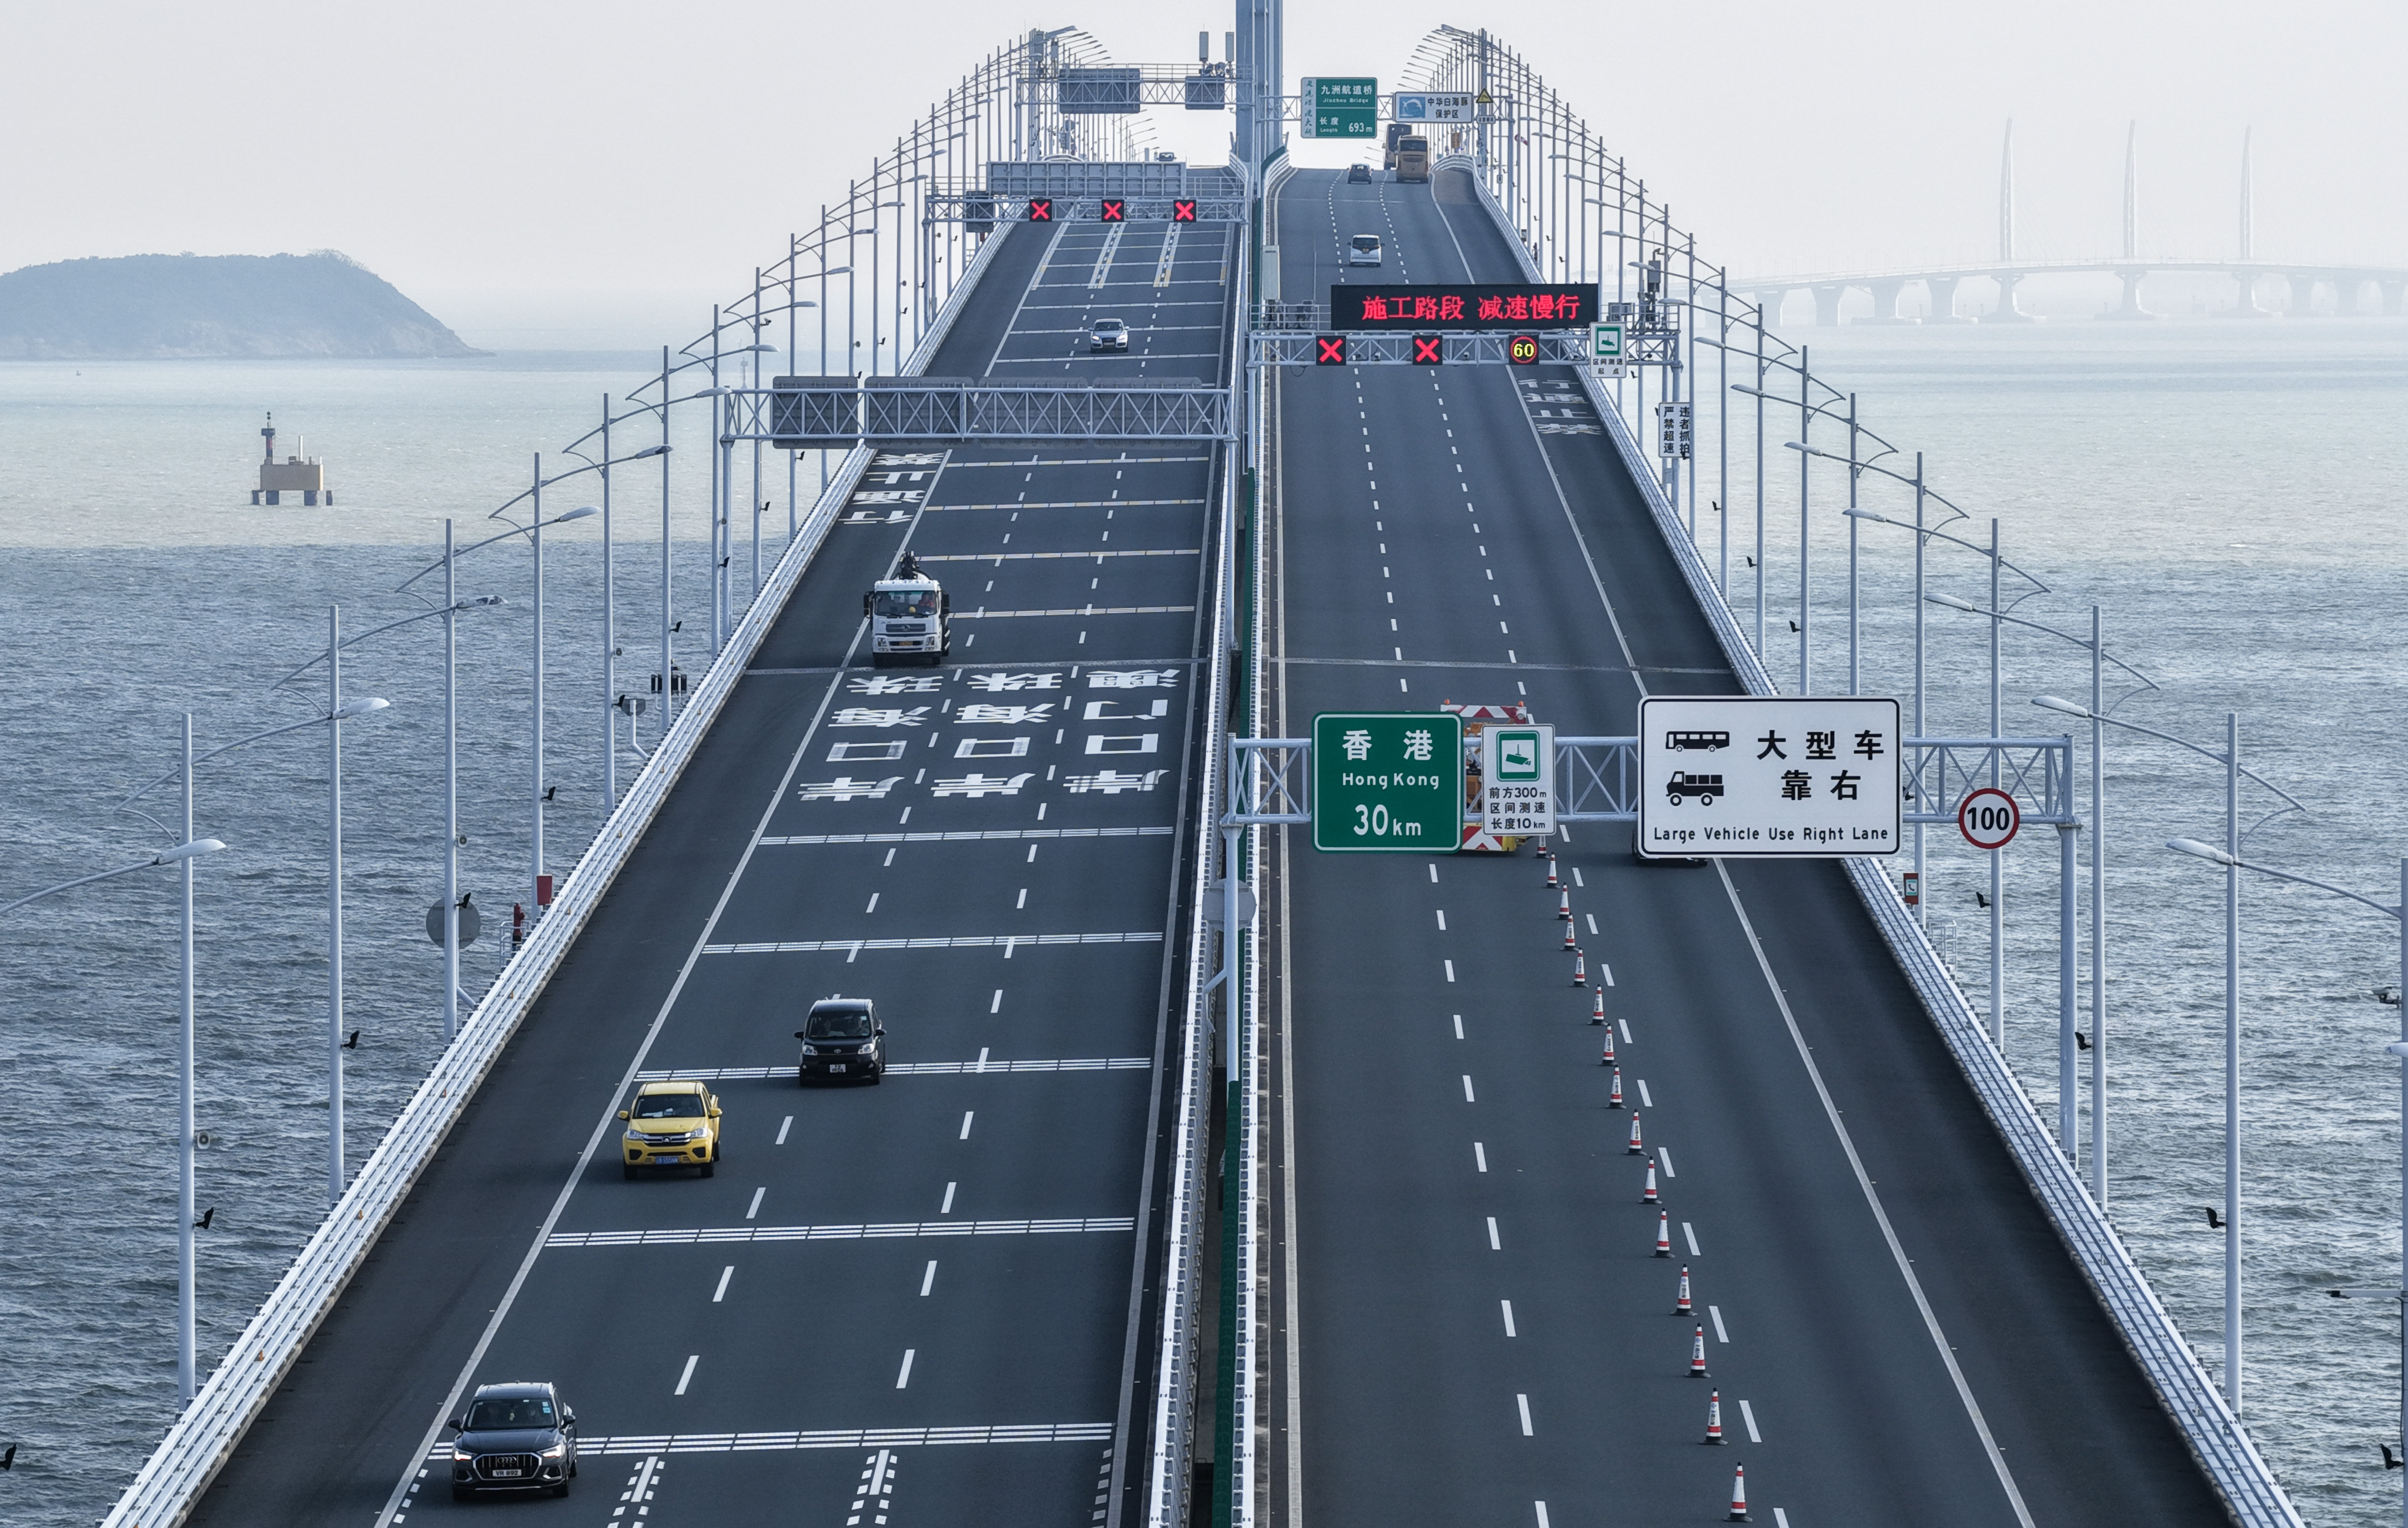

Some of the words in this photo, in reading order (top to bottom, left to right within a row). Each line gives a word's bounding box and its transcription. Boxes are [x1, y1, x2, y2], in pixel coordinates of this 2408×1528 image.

[1320, 85, 1373, 95] 九洲航道桥
[1319, 116, 1339, 125] 长度
[1436, 109, 1459, 119] 保护区
[1362, 295, 1464, 321] 施工路段
[1477, 293, 1580, 321] 减速慢行
[1513, 343, 1534, 357] 60
[1663, 406, 1674, 454] 严禁超速
[1342, 729, 1433, 761] 香港
[1755, 729, 1885, 761] 大型车
[1342, 773, 1388, 790] Hong
[1393, 773, 1440, 790] Kong
[1781, 769, 1862, 801] 靠右
[1490, 801, 1546, 814] 区间测速
[1966, 807, 2010, 831] 100
[1653, 827, 1696, 844] Large
[1704, 827, 1760, 840] Vehicle
[1768, 827, 1795, 840] Use
[1803, 827, 1844, 844] Right
[1852, 827, 1888, 840] Lane
